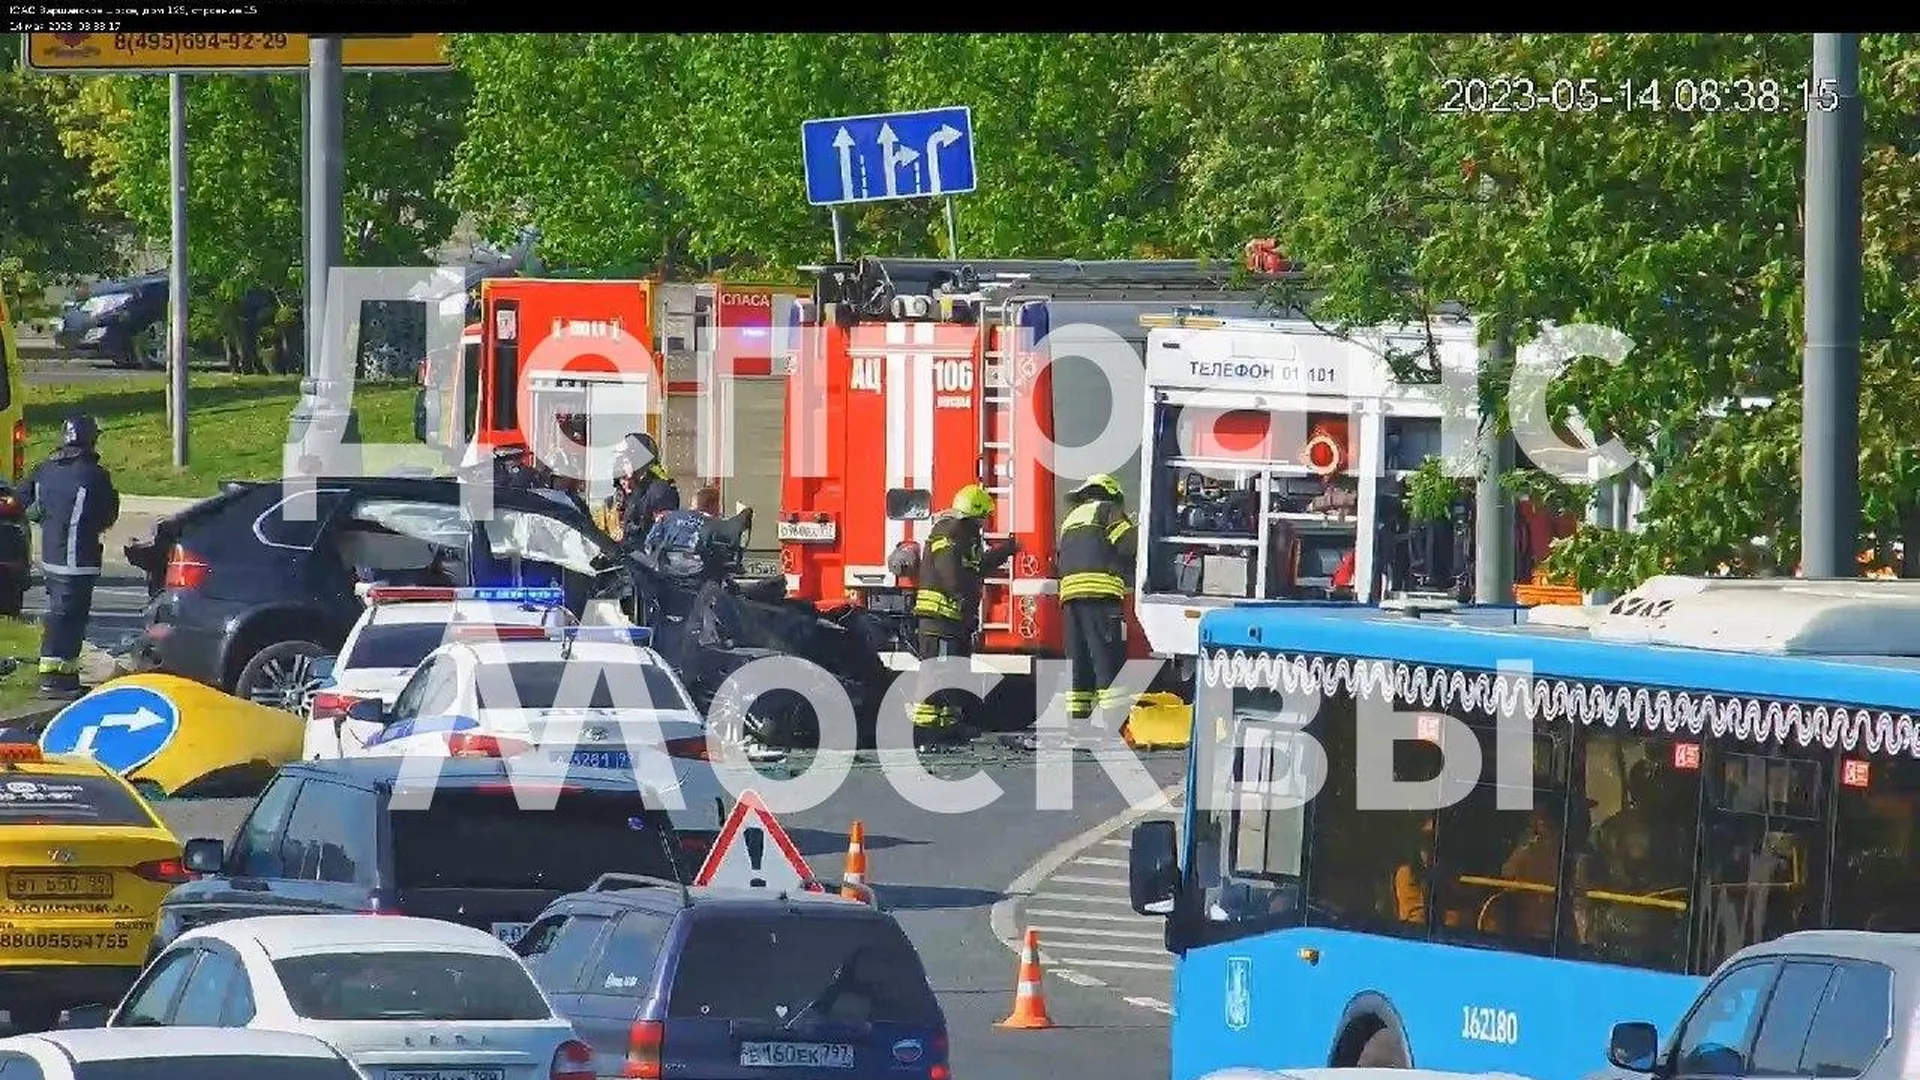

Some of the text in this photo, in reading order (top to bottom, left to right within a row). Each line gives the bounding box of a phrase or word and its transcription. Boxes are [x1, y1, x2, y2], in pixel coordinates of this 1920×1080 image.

[850, 357, 882, 394] АЦ
[933, 359, 974, 392] 106
[1189, 361, 1275, 380] ТЕЛЕФОН
[1461, 1005, 1518, 1045] 162180
